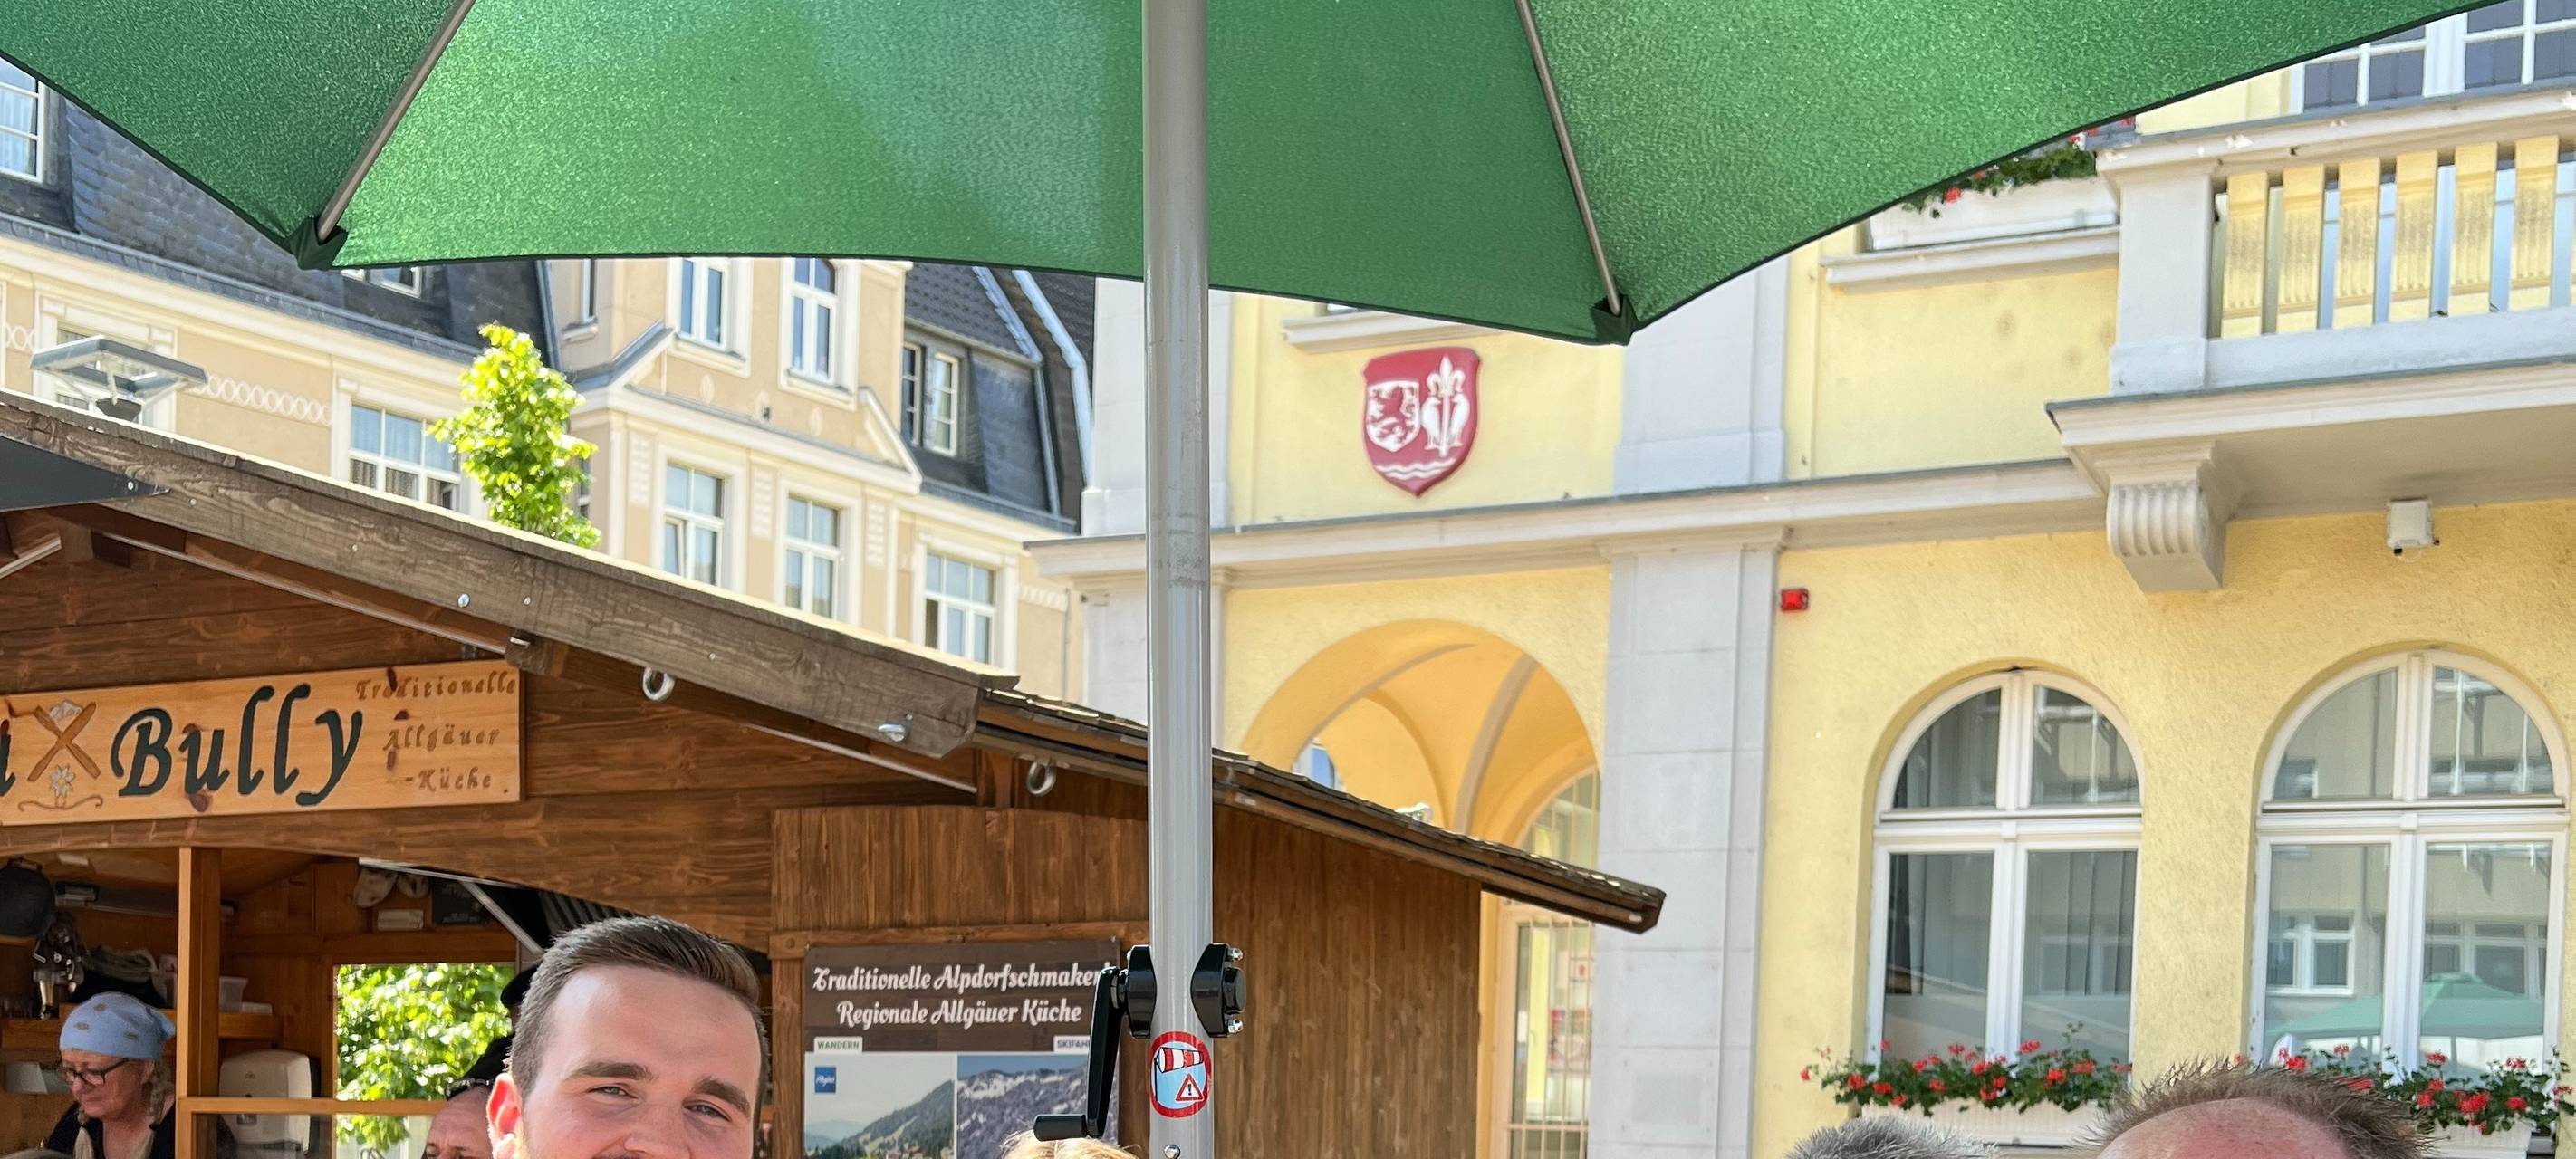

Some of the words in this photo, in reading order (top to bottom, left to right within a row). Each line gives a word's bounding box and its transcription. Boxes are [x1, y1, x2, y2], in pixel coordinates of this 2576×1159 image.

[356, 671, 516, 701] Traditionelle
[111, 684, 363, 806] Bully
[382, 724, 500, 752] Allgäuer
[812, 965, 931, 991] Traditionelle
[932, 962, 1111, 995] Alpdorfschmaker
[837, 1000, 928, 1030] Regionale
[930, 999, 1019, 1030] Allgäuer
[1022, 997, 1082, 1026] Küche
[817, 1040, 860, 1049] WANDERN
[1057, 1039, 1091, 1049] SKIFAH
